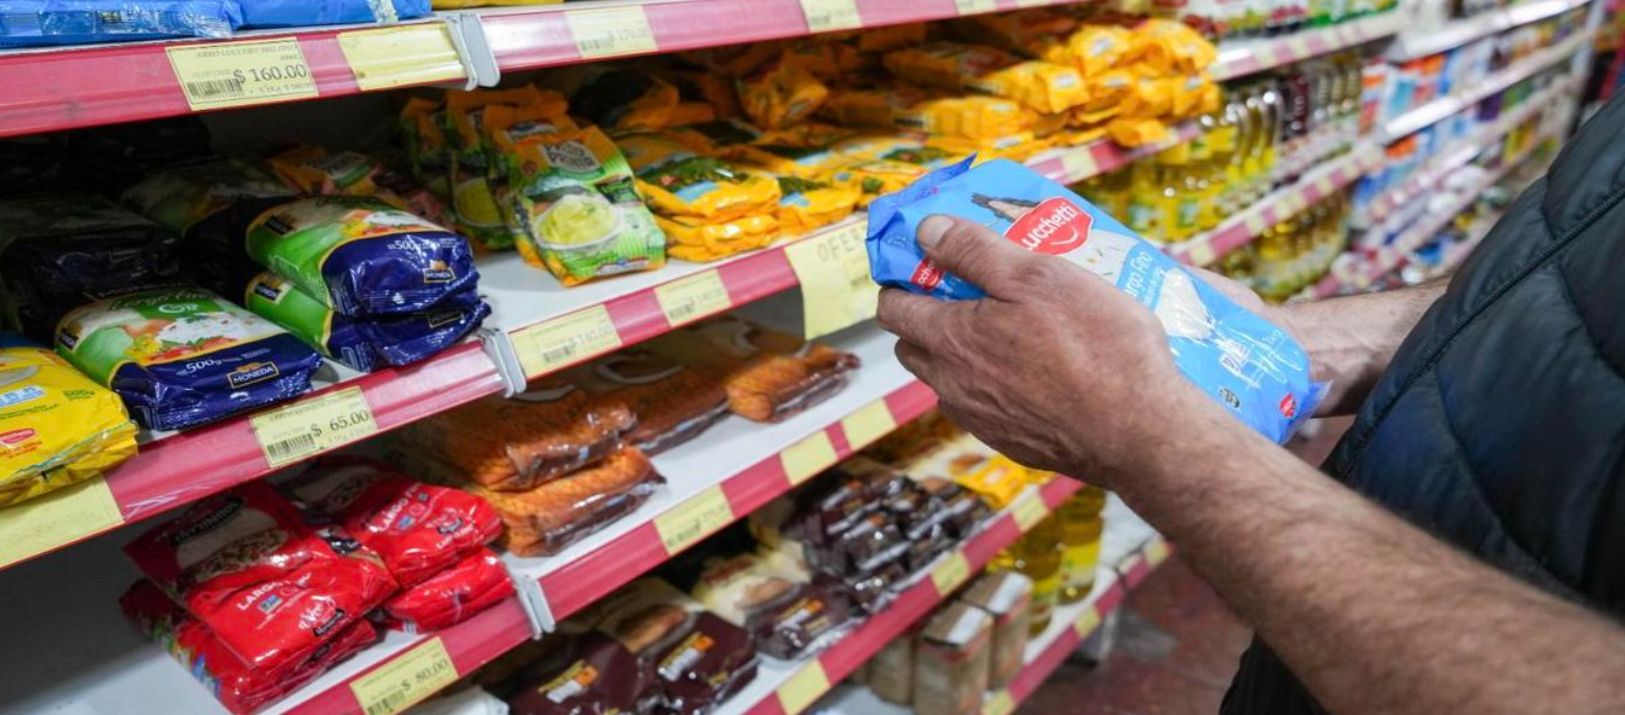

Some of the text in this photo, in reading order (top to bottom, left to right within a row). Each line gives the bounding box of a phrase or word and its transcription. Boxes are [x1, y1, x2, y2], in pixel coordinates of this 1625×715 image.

[233, 63, 307, 84] $ 160.00
[1023, 203, 1079, 251] ucchetti
[186, 359, 222, 375] 500g
[232, 365, 274, 384] MONEDA
[311, 423, 322, 437] $
[329, 408, 370, 432] 65.00
[414, 658, 450, 683] 80.00
